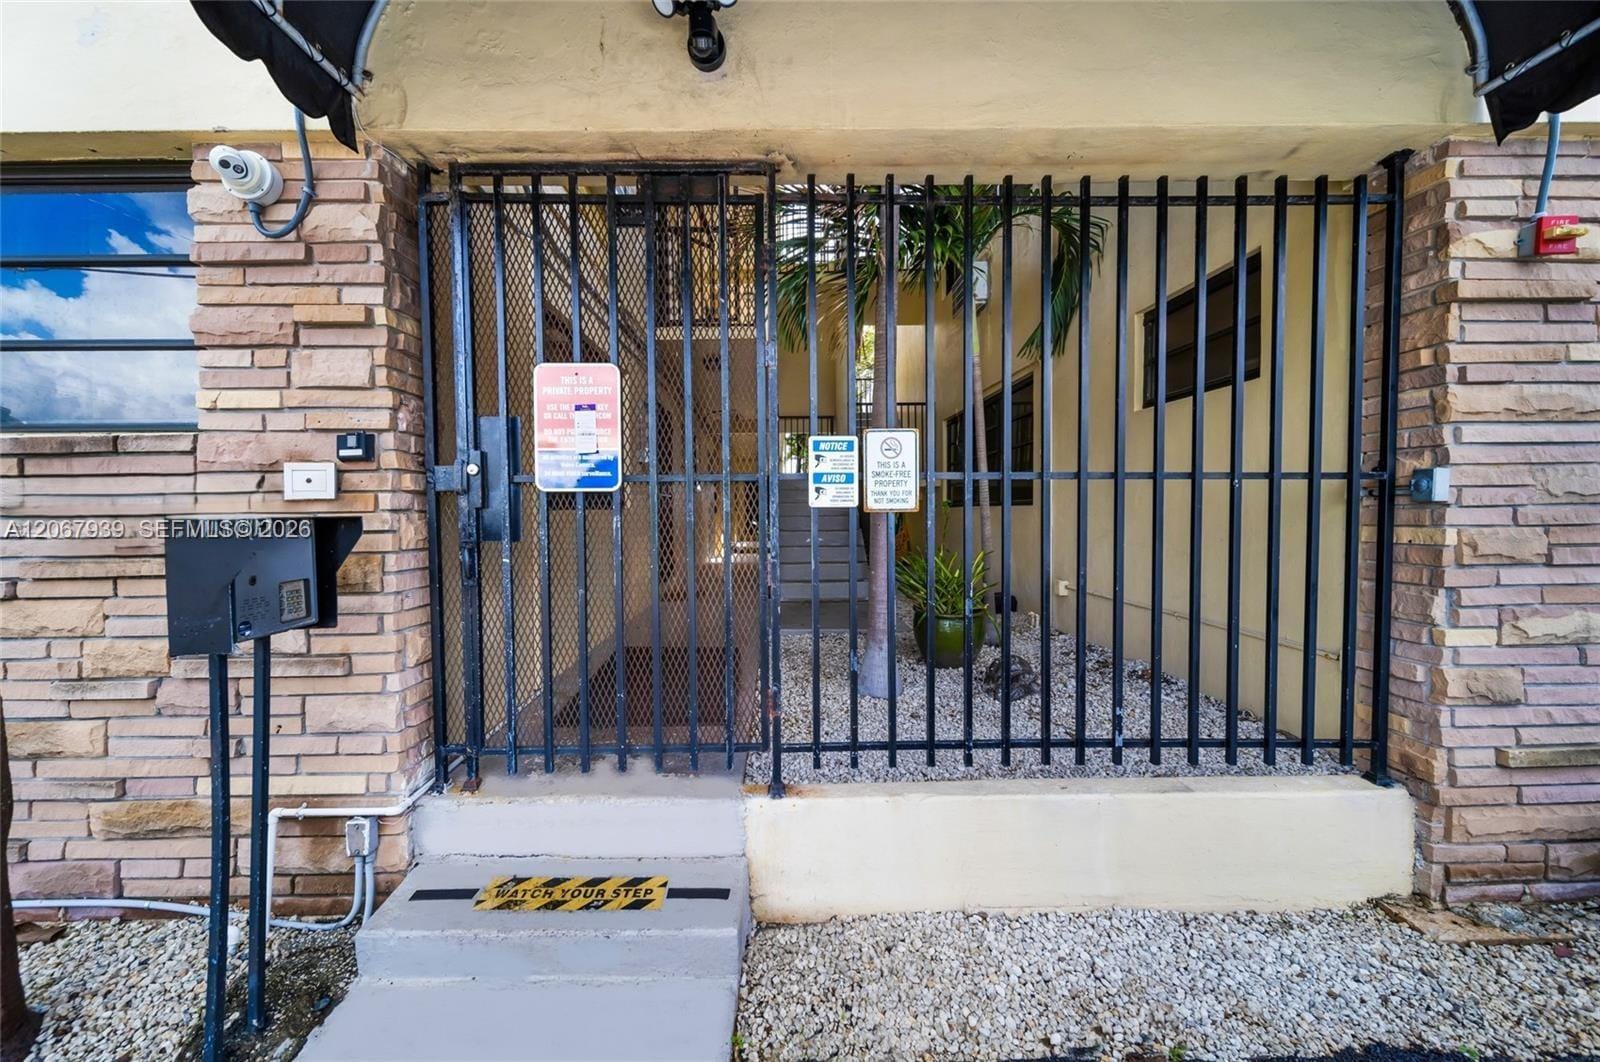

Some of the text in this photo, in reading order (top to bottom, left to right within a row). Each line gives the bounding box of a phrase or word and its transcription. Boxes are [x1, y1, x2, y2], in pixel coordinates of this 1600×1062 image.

[560, 376, 594, 385] THIS IS A
[542, 386, 612, 395] PRIVATE PROPERTY
[553, 412, 568, 420] CALL
[818, 442, 849, 451] NOTICE
[877, 461, 906, 469] THIS IS A
[820, 474, 847, 483] AVISO
[871, 470, 912, 478] SMOKE-FREE
[874, 480, 908, 488] PROPERTY
[494, 888, 654, 899] WATCH YOUR STEP
